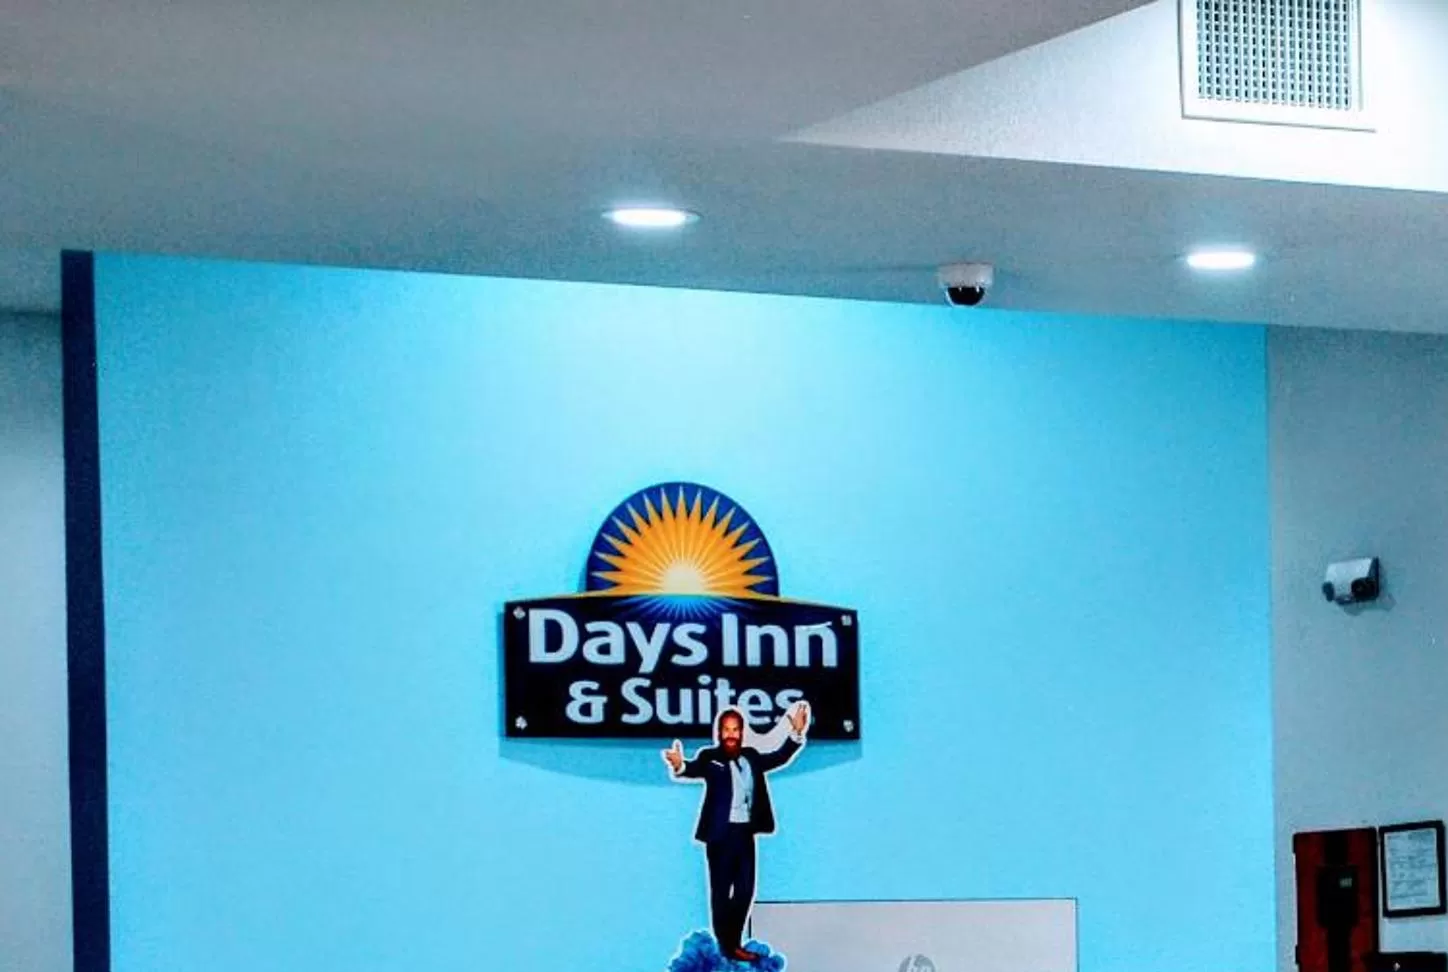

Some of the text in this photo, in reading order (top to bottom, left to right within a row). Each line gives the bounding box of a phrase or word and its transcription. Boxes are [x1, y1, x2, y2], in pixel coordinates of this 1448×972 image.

[528, 607, 838, 674] Days Inn
[565, 674, 804, 726] & Suites
